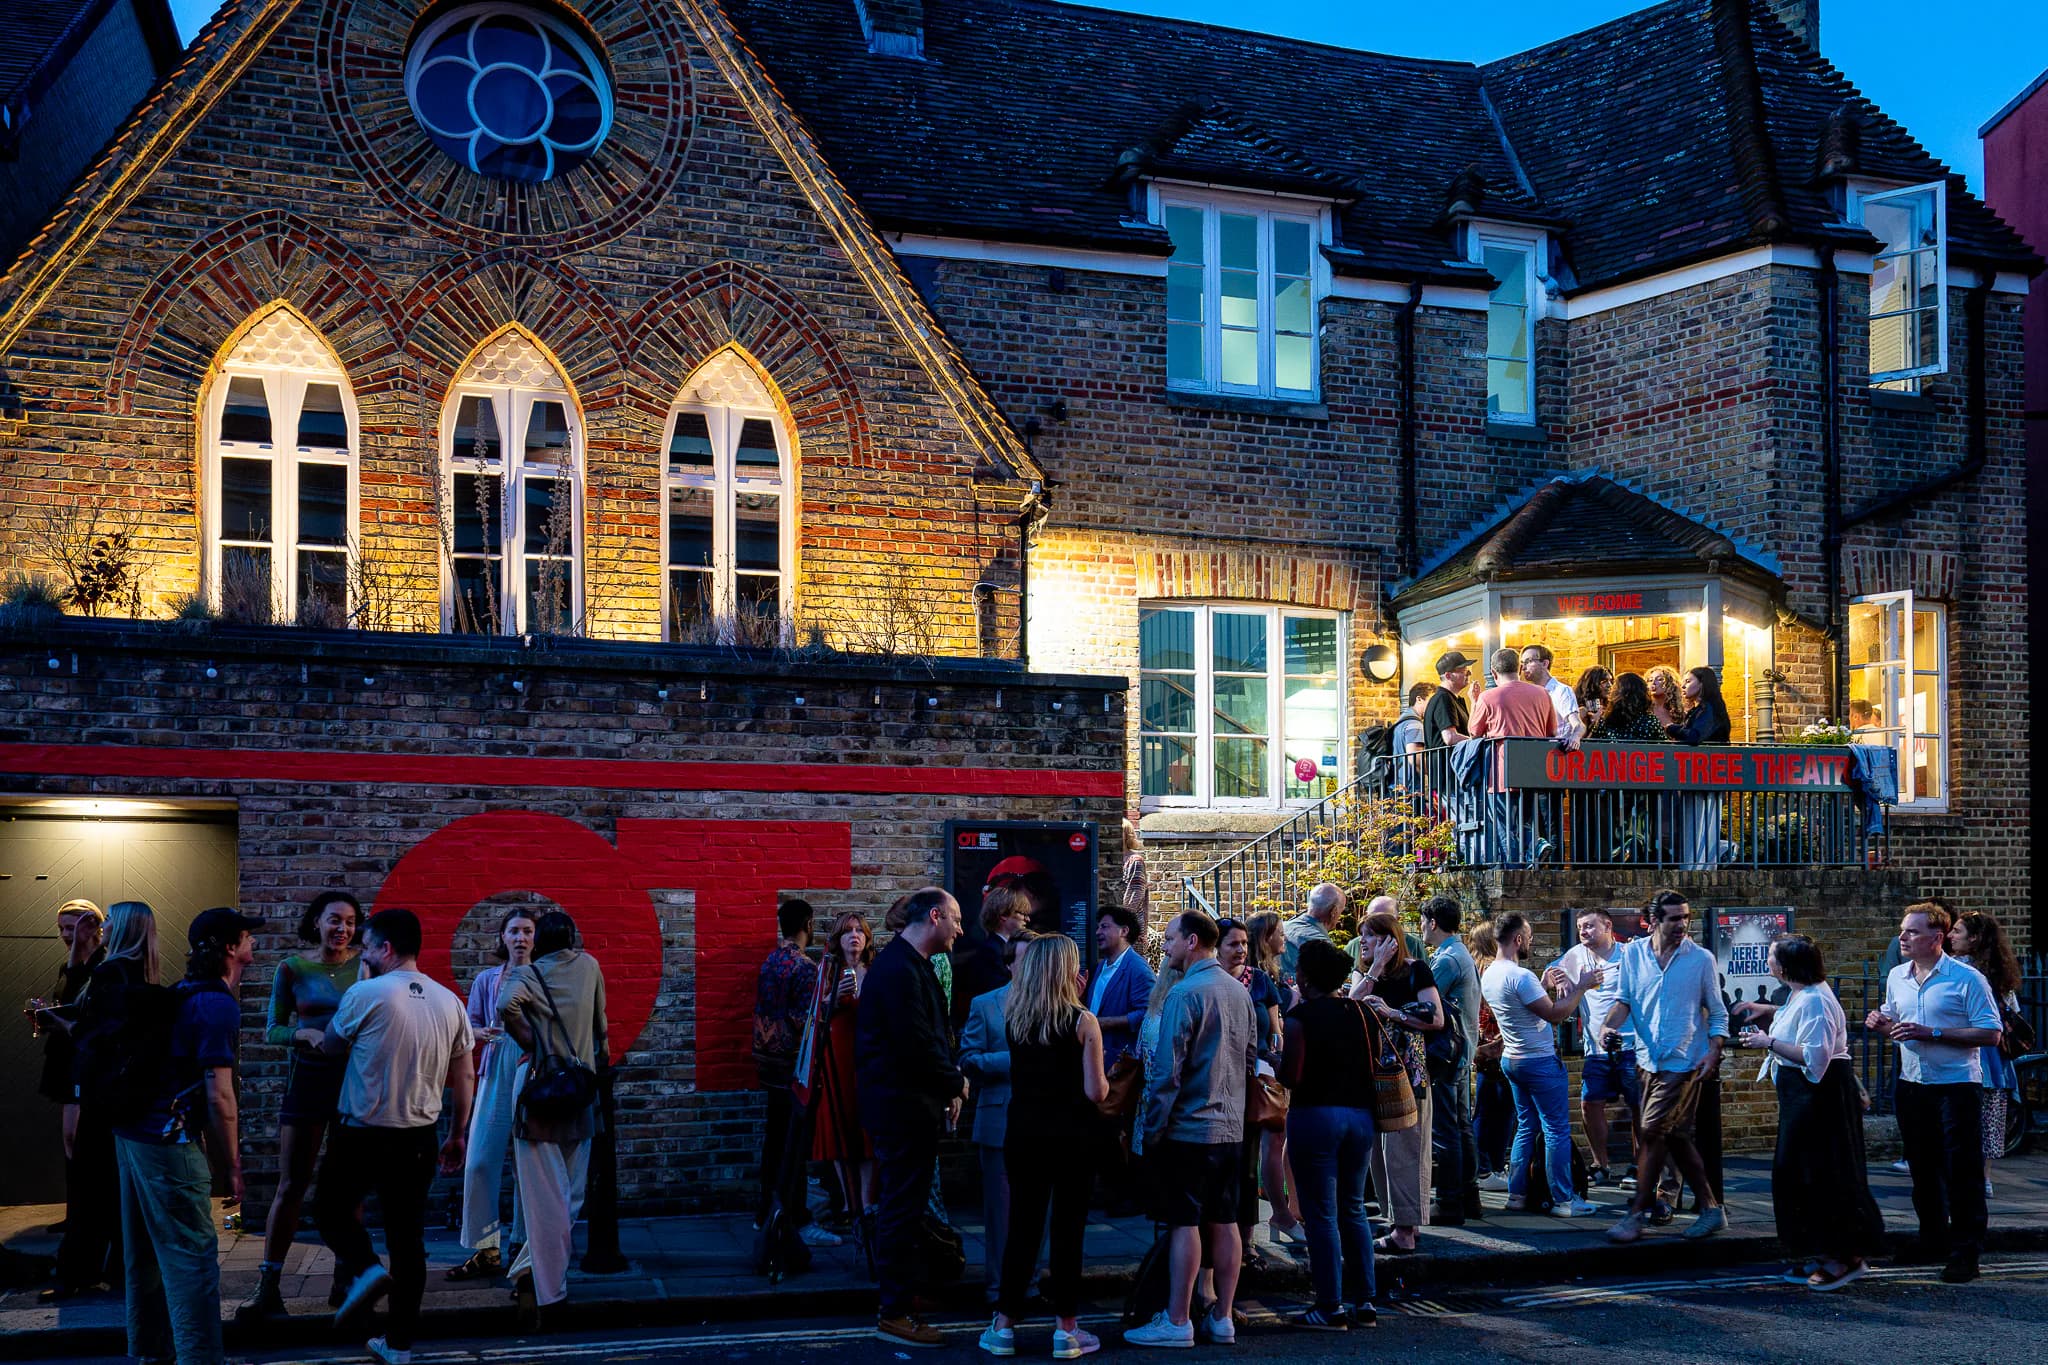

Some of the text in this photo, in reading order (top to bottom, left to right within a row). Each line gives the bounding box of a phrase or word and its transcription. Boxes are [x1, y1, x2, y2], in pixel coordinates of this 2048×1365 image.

[1557, 593, 1642, 612] WELCOME
[1546, 749, 1849, 786] ORANGE TREE THEATR
[366, 810, 851, 1091] OT
[1731, 946, 1759, 960] HERE
[1727, 960, 1770, 975] AMERIC
